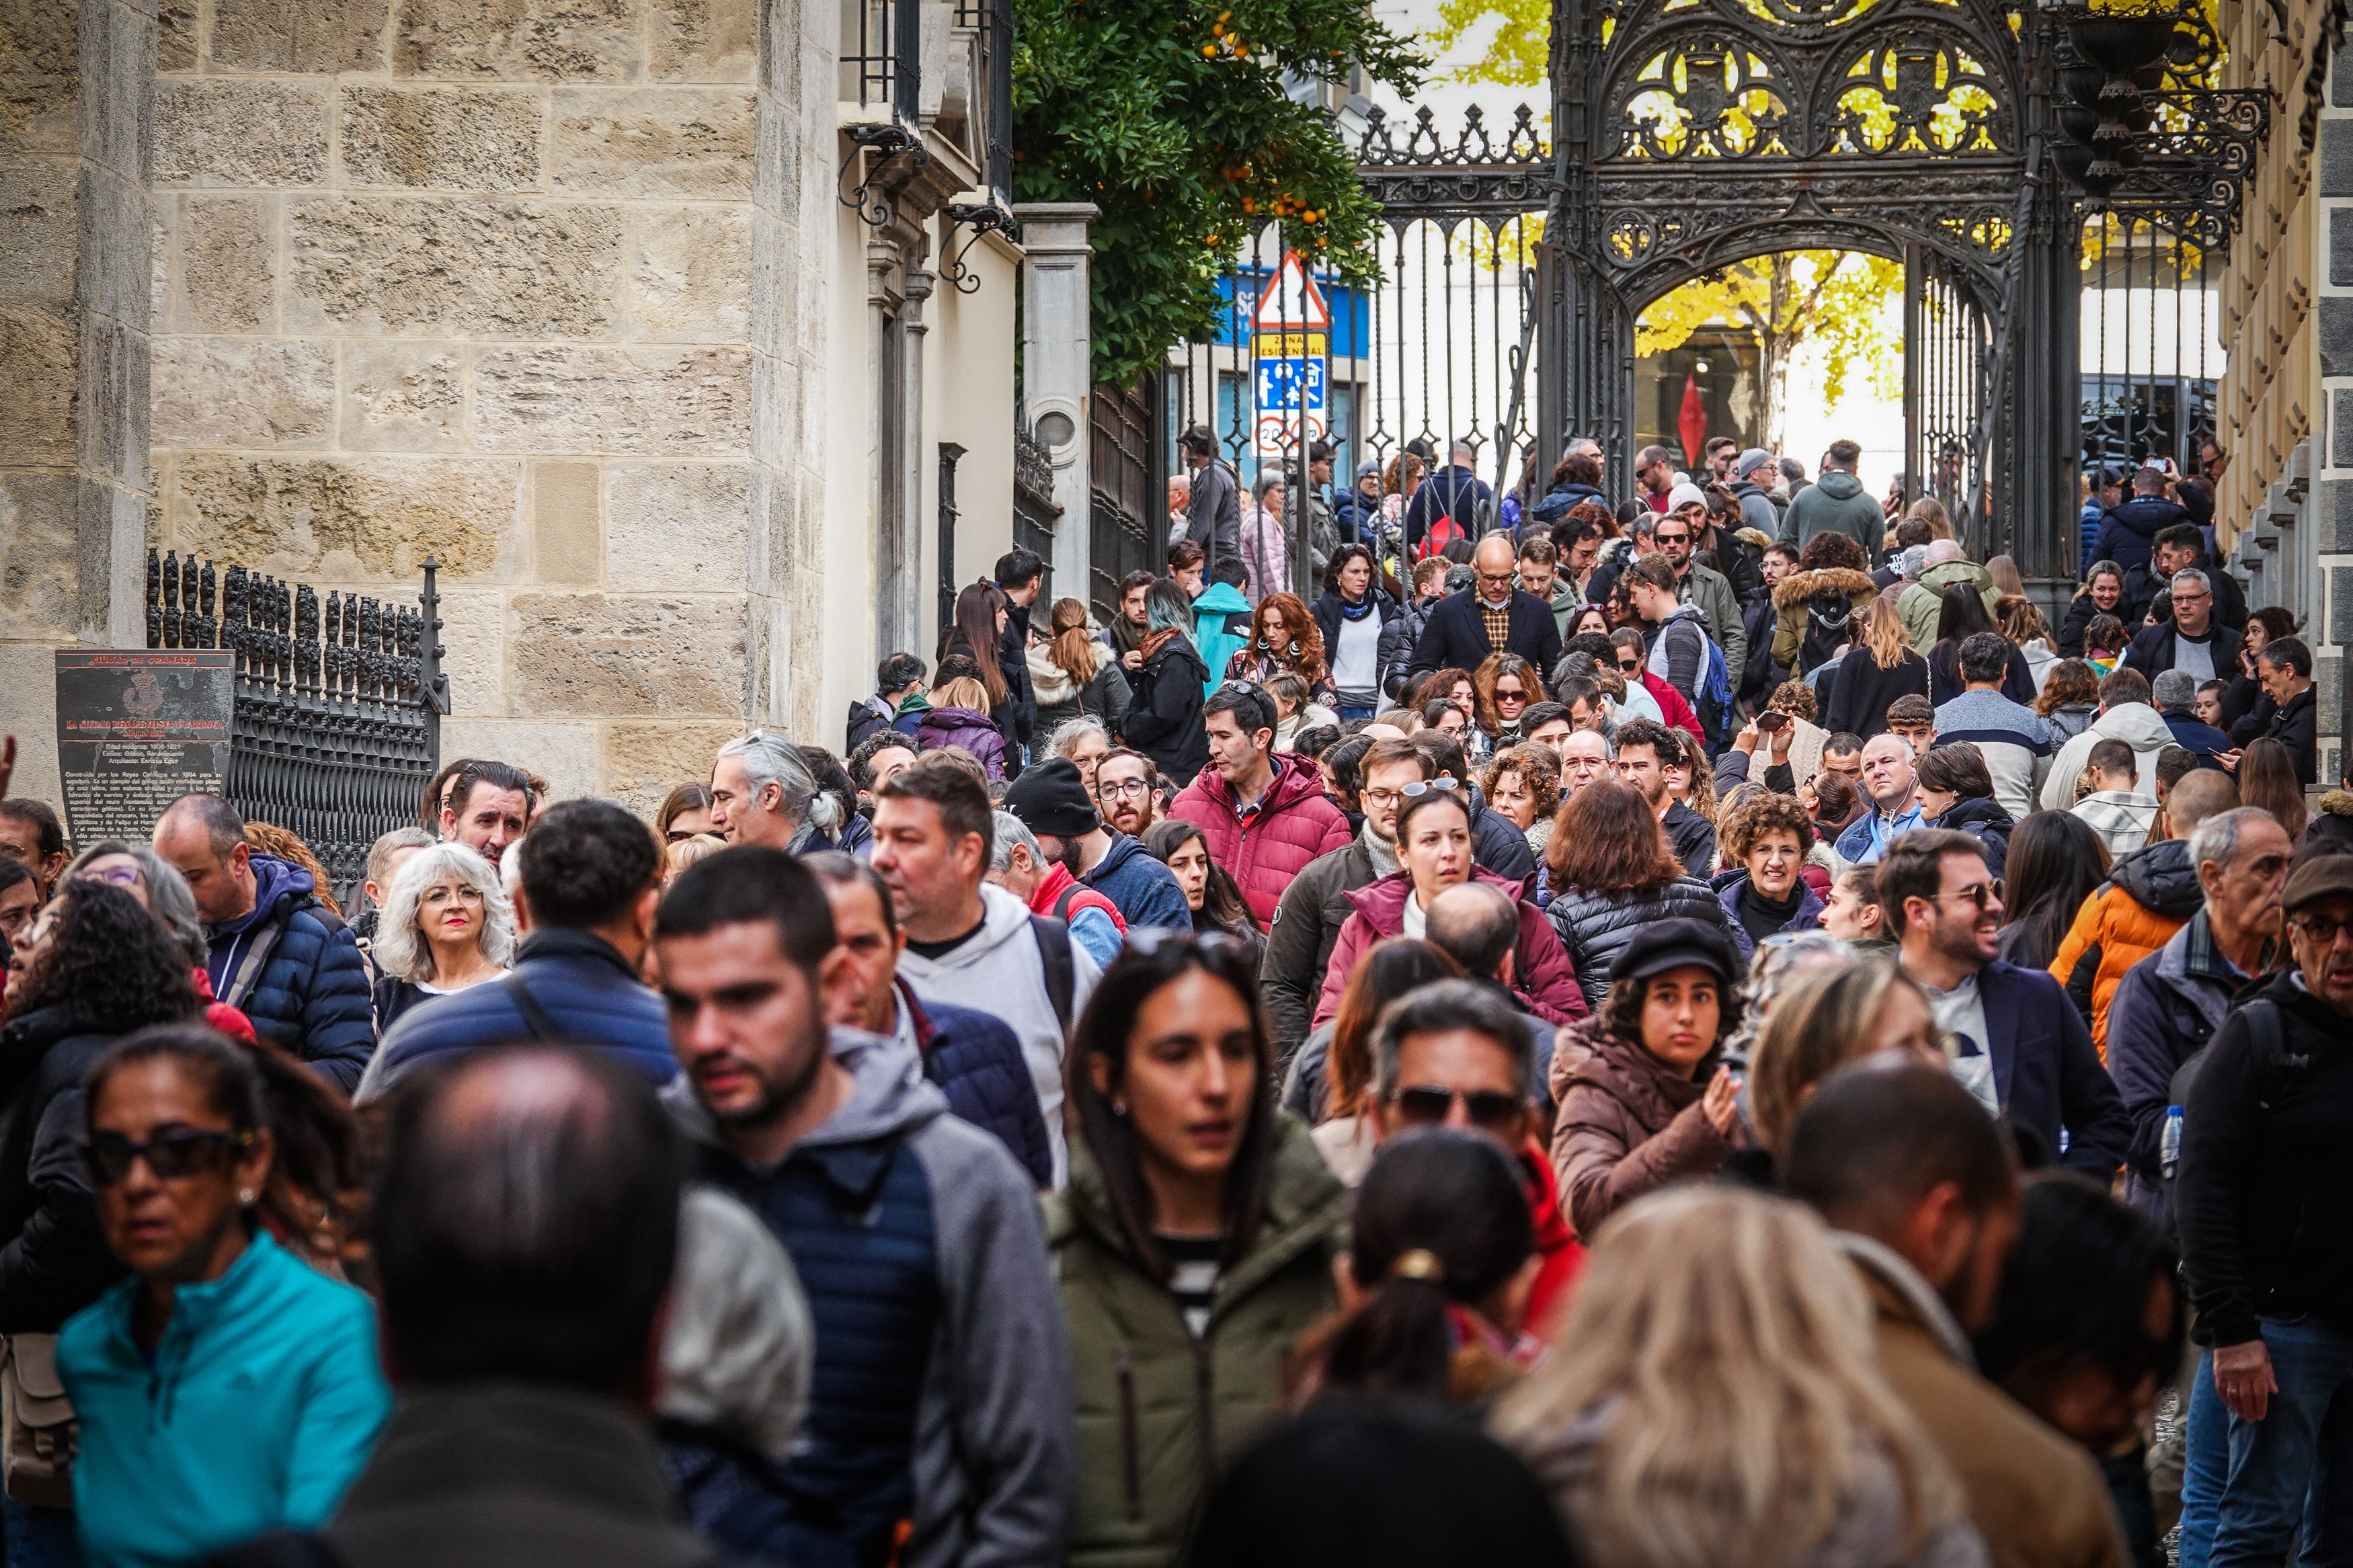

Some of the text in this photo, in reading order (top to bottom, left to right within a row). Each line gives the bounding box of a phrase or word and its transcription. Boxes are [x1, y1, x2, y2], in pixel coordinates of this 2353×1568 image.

[1263, 429, 1280, 439] 20
[67, 720, 77, 729] LA
[80, 720, 111, 729] CIUDAD
[112, 720, 173, 729] RENACENTISTA
[184, 720, 223, 729] BARROCA
